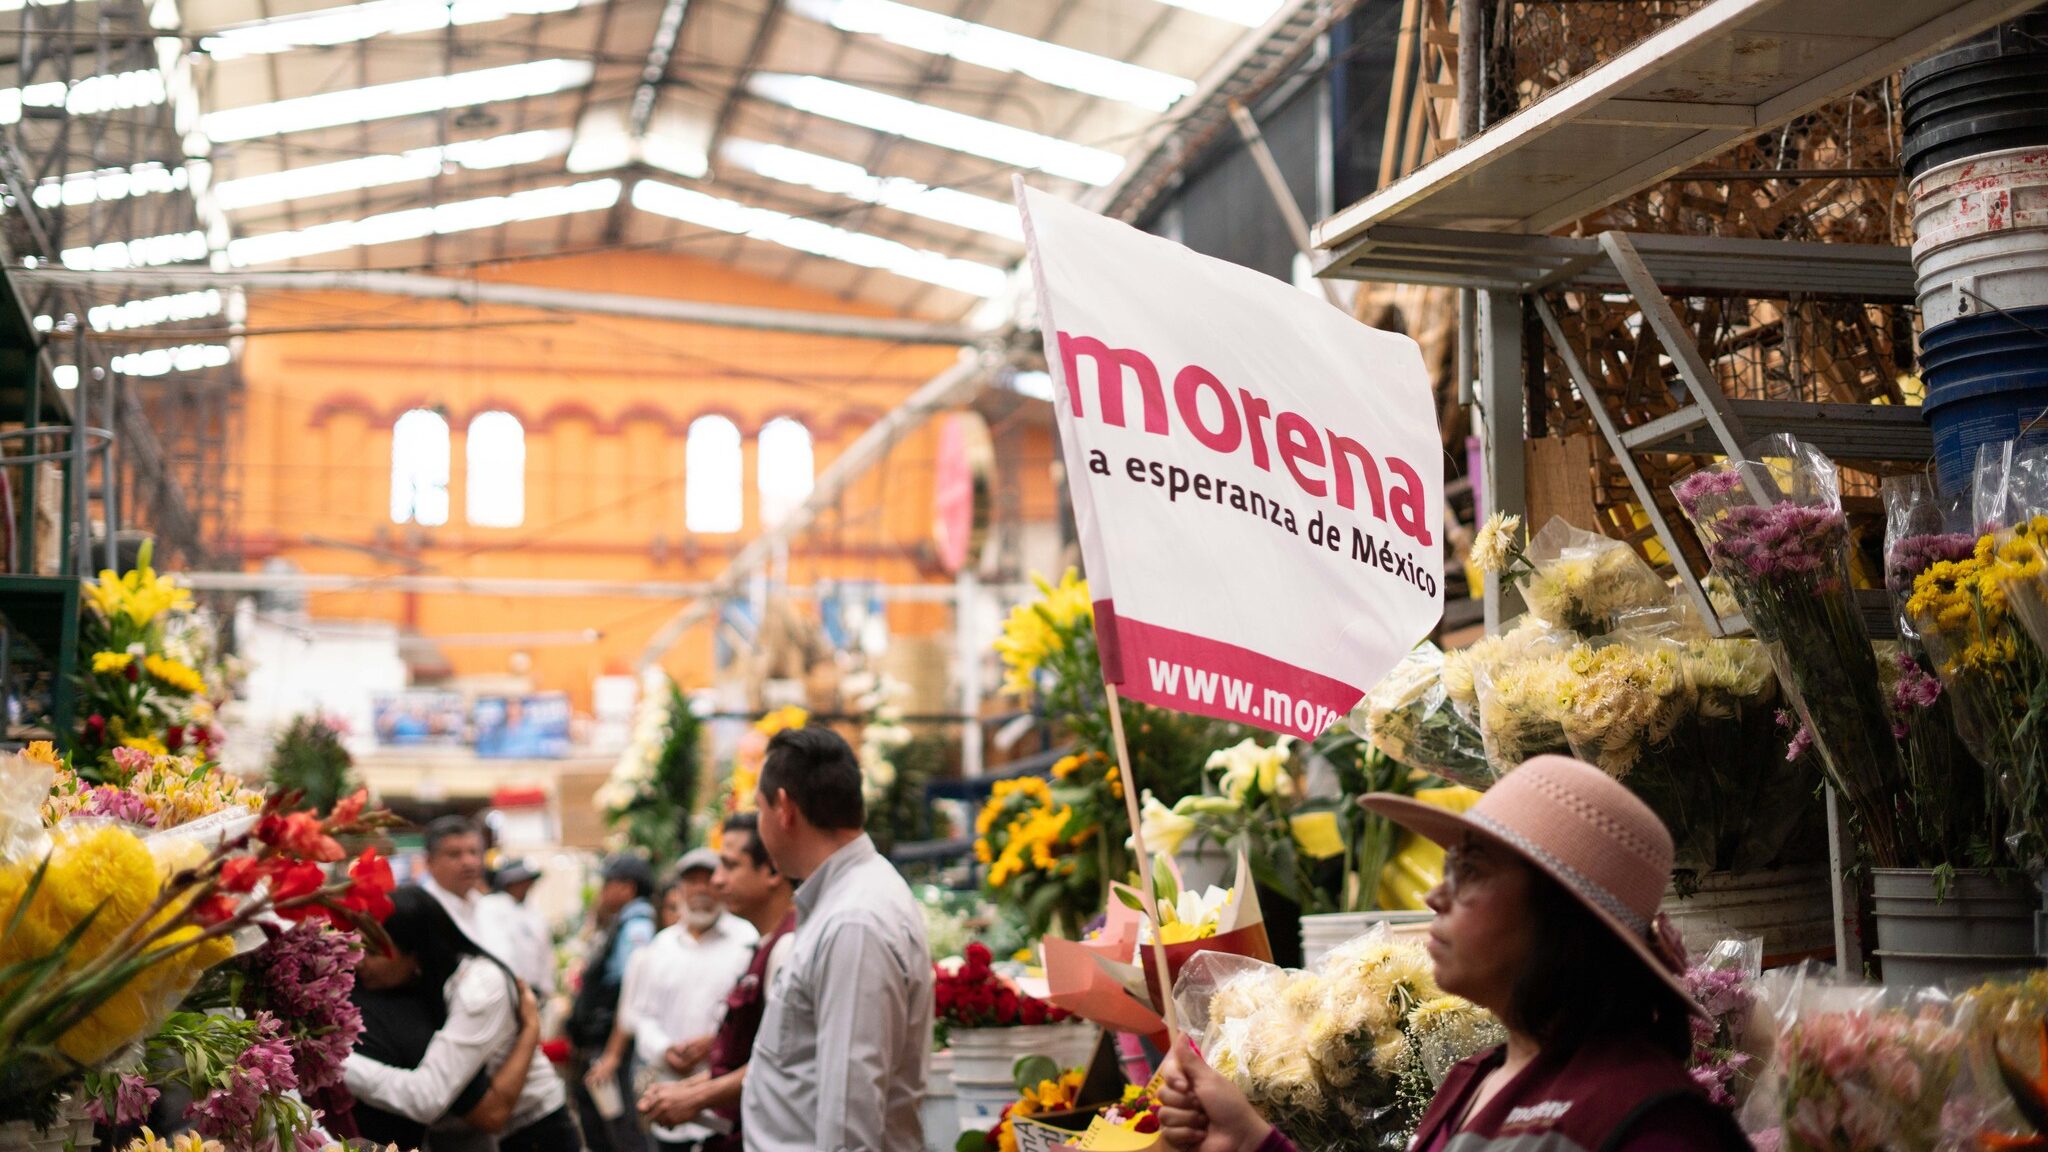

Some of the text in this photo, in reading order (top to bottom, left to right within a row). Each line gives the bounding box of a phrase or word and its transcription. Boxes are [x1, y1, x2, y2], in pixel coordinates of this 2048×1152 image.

[1057, 331, 1433, 547] morena
[1126, 457, 1299, 536] esperanza
[1308, 510, 1341, 552] de
[1352, 527, 1436, 598] México
[1148, 657, 1343, 737] www.more
